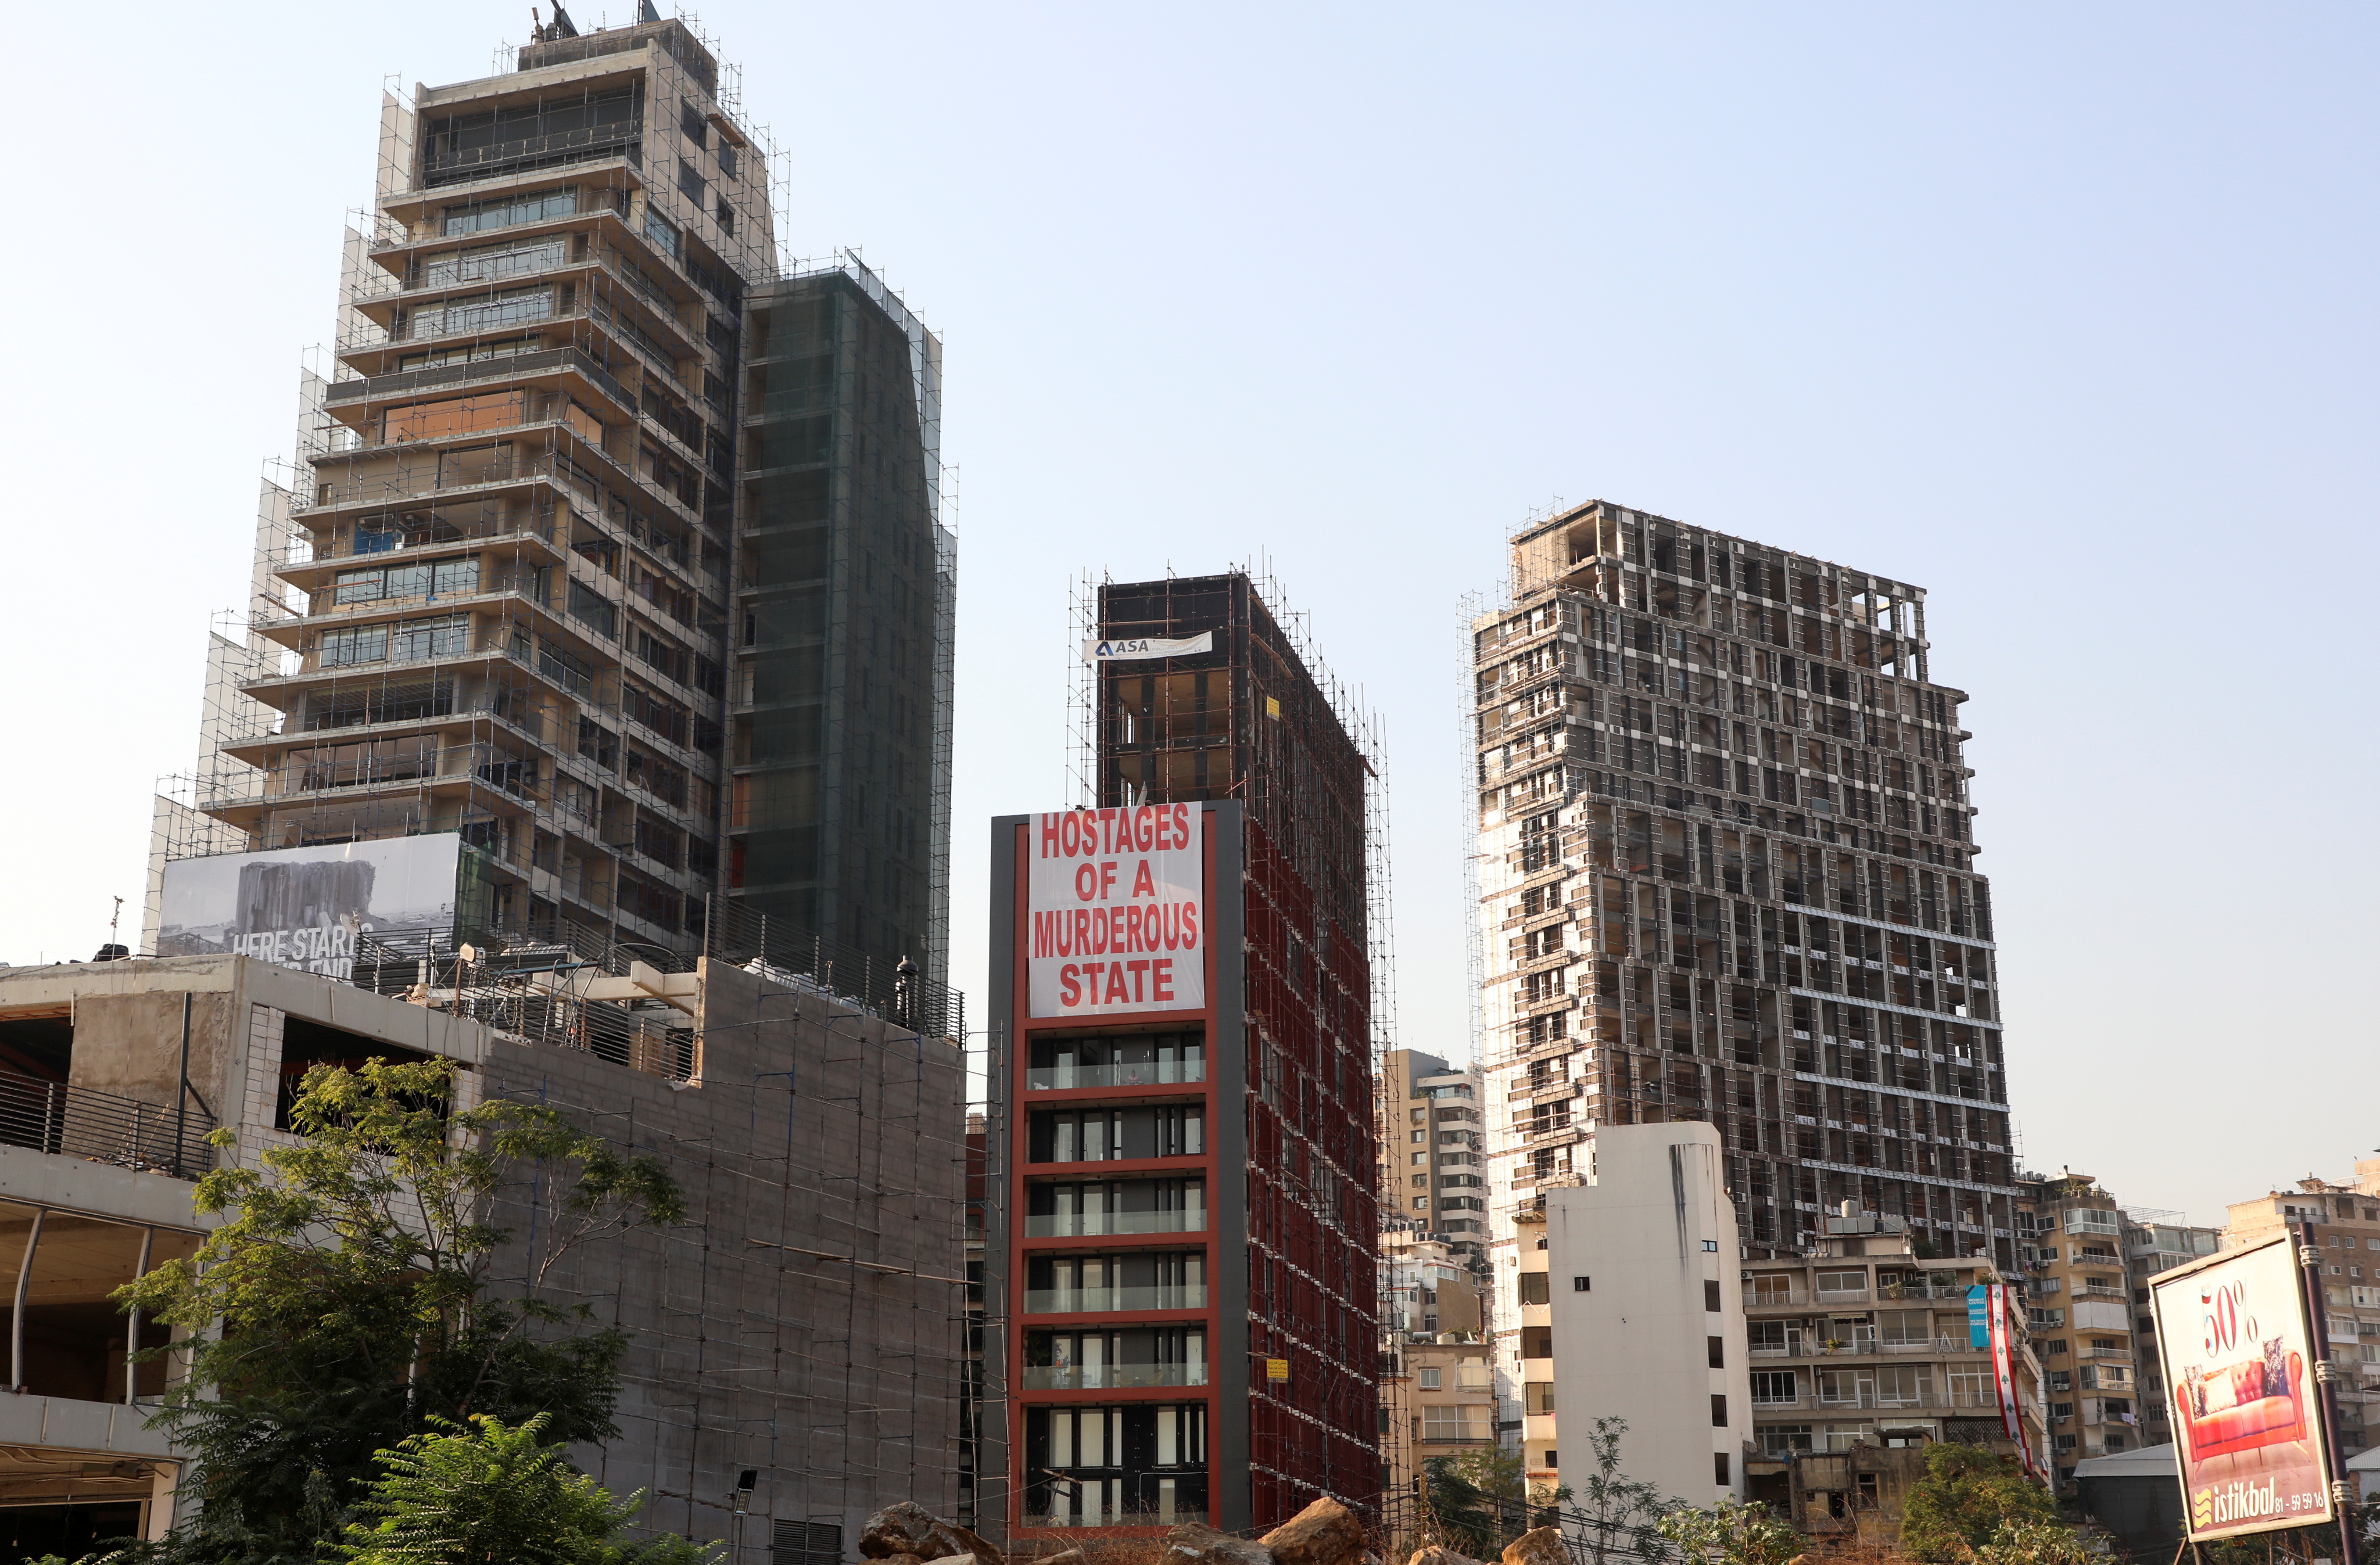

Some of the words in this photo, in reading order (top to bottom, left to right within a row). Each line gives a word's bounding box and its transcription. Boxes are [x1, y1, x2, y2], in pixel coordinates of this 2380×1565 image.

[1116, 640, 1149, 652] ASA
[1041, 802, 1189, 859] HOSTAGES
[1075, 861, 1117, 902] OF
[1132, 859, 1155, 898] A
[233, 930, 288, 962] HERE
[1034, 901, 1198, 959] MURDEROUS
[1060, 958, 1174, 1007] STATE
[2201, 1277, 2258, 1358] 50%
[2214, 1476, 2274, 1523] istikbal
[2275, 1497, 2284, 1513] 81
[2291, 1494, 2301, 1511] 59
[2303, 1492, 2313, 1510] 59
[2314, 1491, 2324, 1508] 16
